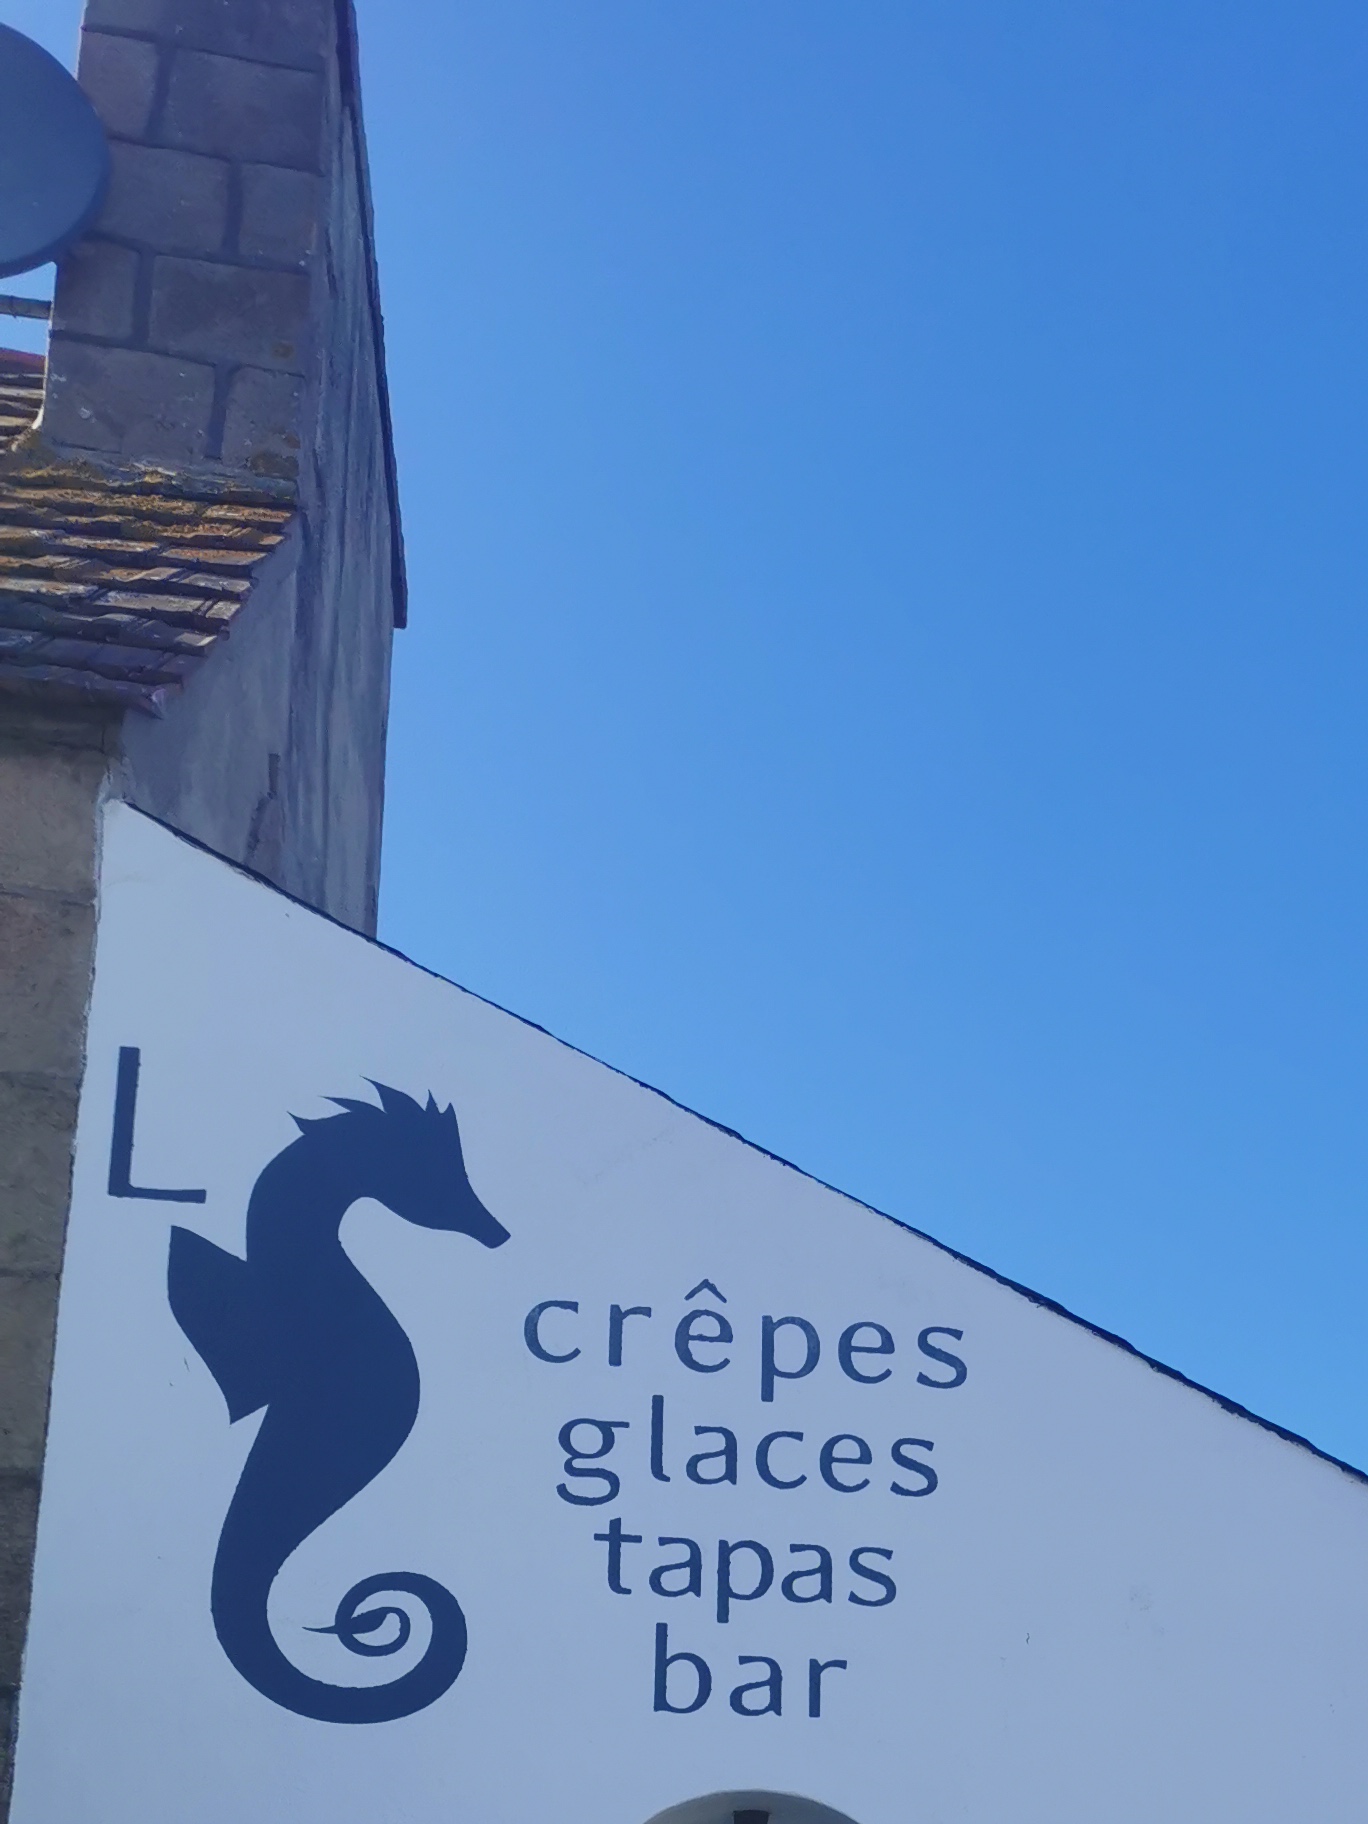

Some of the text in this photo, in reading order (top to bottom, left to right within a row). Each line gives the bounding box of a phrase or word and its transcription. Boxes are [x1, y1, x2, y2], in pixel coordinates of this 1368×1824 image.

[106, 1045, 208, 1205] L
[522, 1278, 969, 1403] crêpes
[554, 1394, 940, 1507] glaces
[592, 1516, 898, 1624] tapas
[651, 1621, 849, 1719] bar
